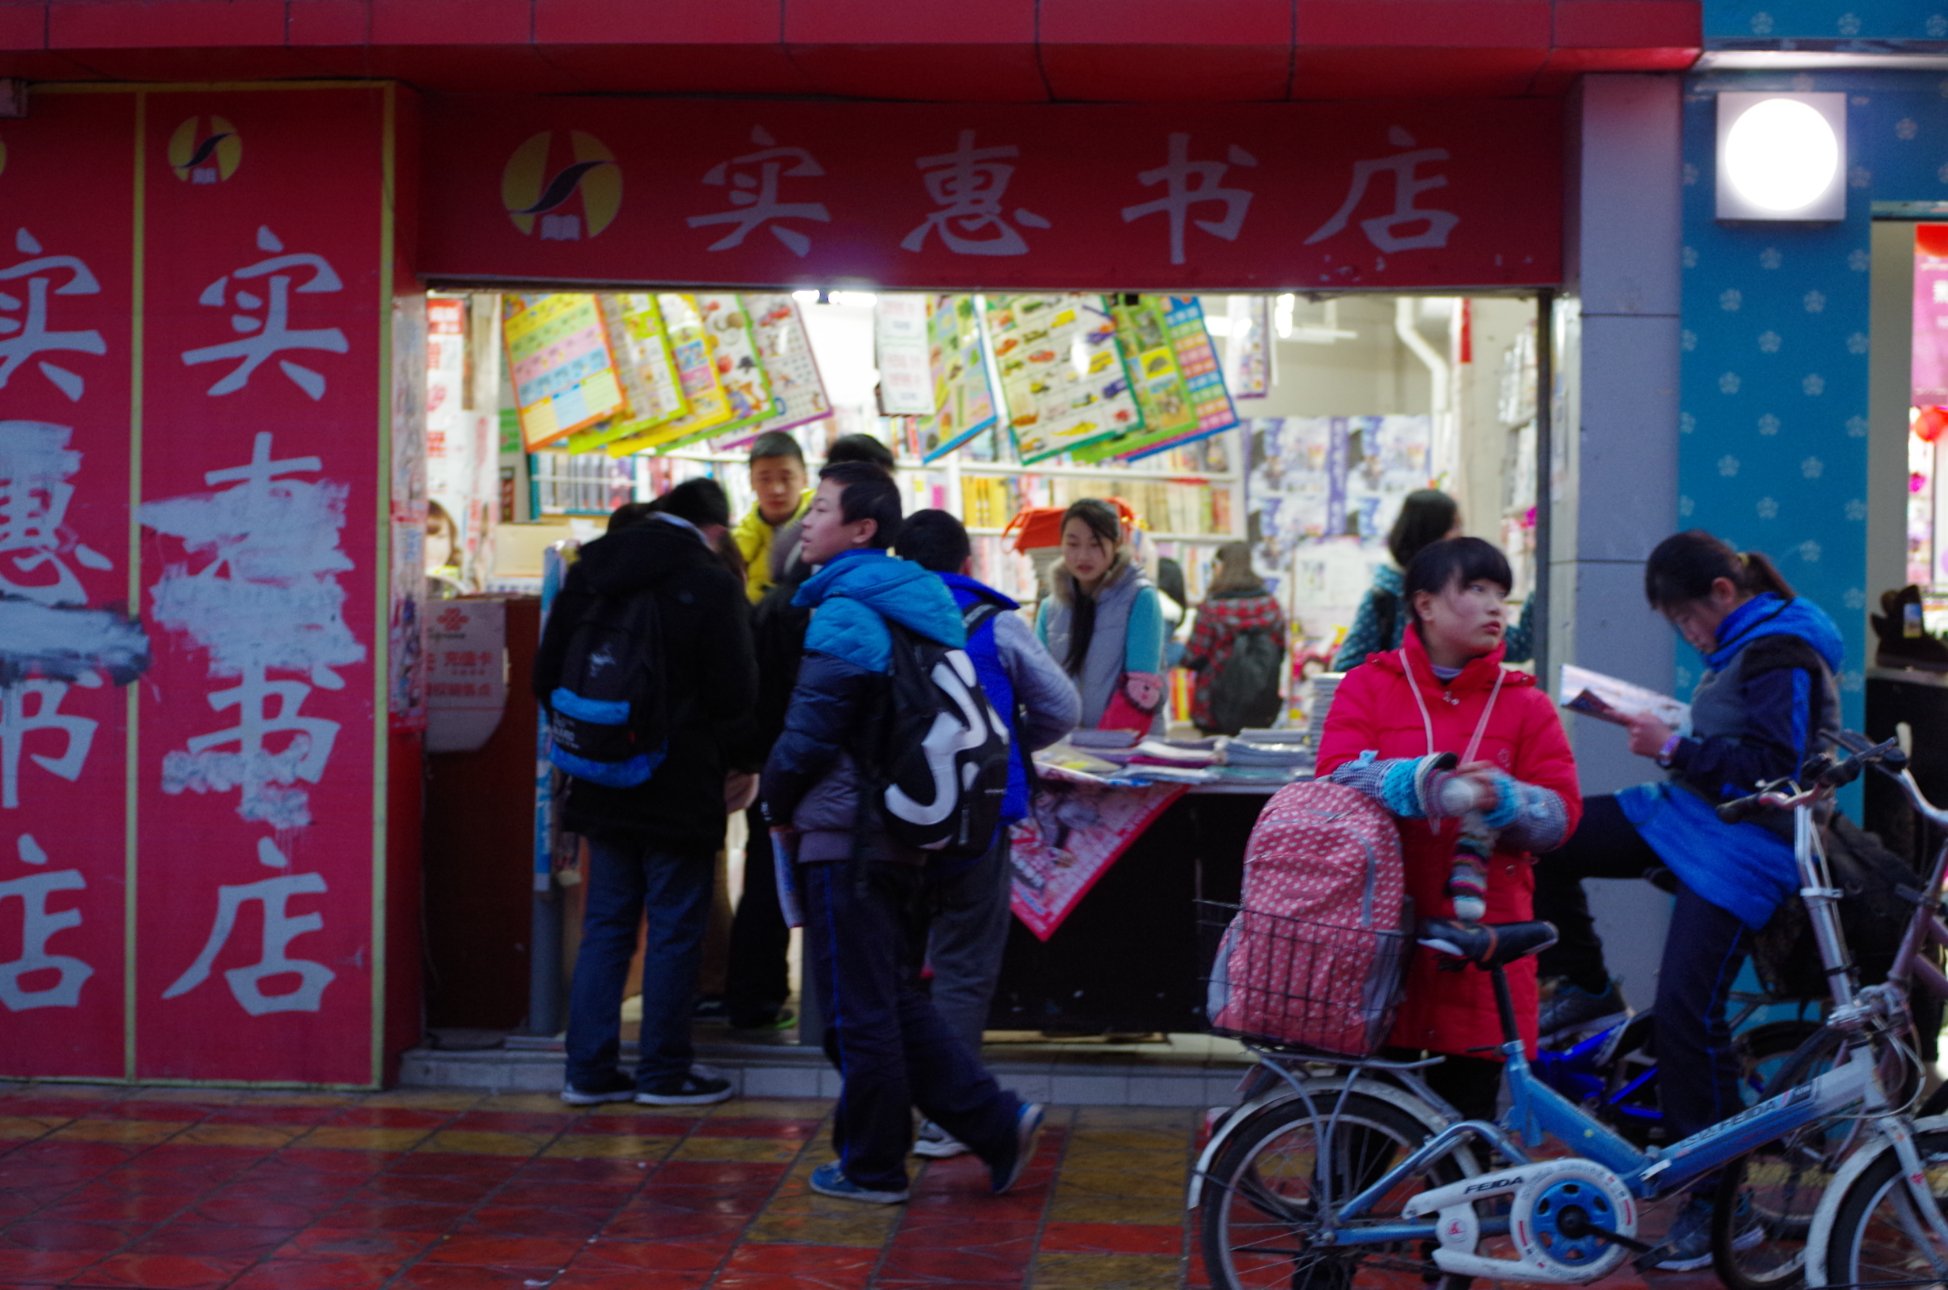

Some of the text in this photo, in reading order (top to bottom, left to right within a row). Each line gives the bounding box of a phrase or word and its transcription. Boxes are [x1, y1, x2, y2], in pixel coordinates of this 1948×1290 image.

[686, 124, 1460, 265] 实惠书店
[1464, 1176, 1524, 1195] FEIDA
